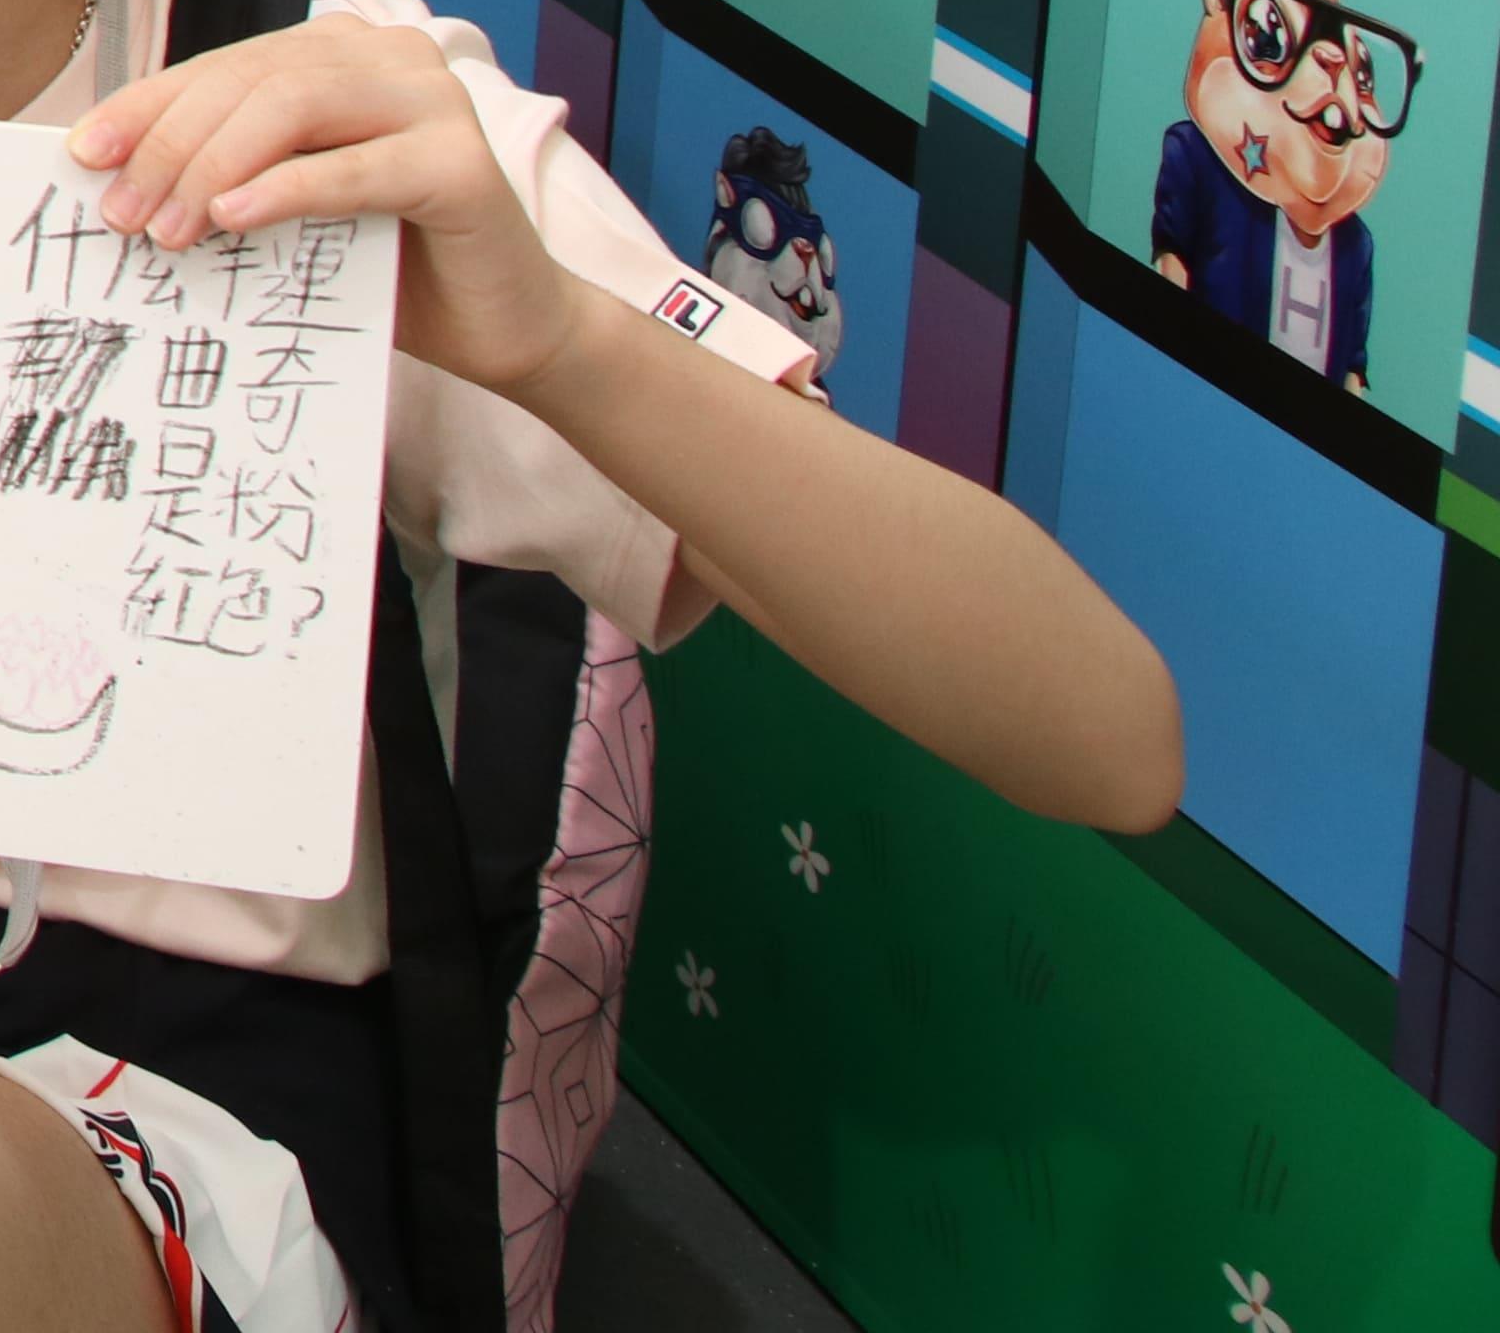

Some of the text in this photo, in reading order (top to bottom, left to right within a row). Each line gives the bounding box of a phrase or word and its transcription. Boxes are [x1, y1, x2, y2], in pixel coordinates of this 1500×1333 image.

[1279, 266, 1326, 348] H
[158, 327, 339, 453] 曲奇
[141, 421, 317, 562] 是粉
